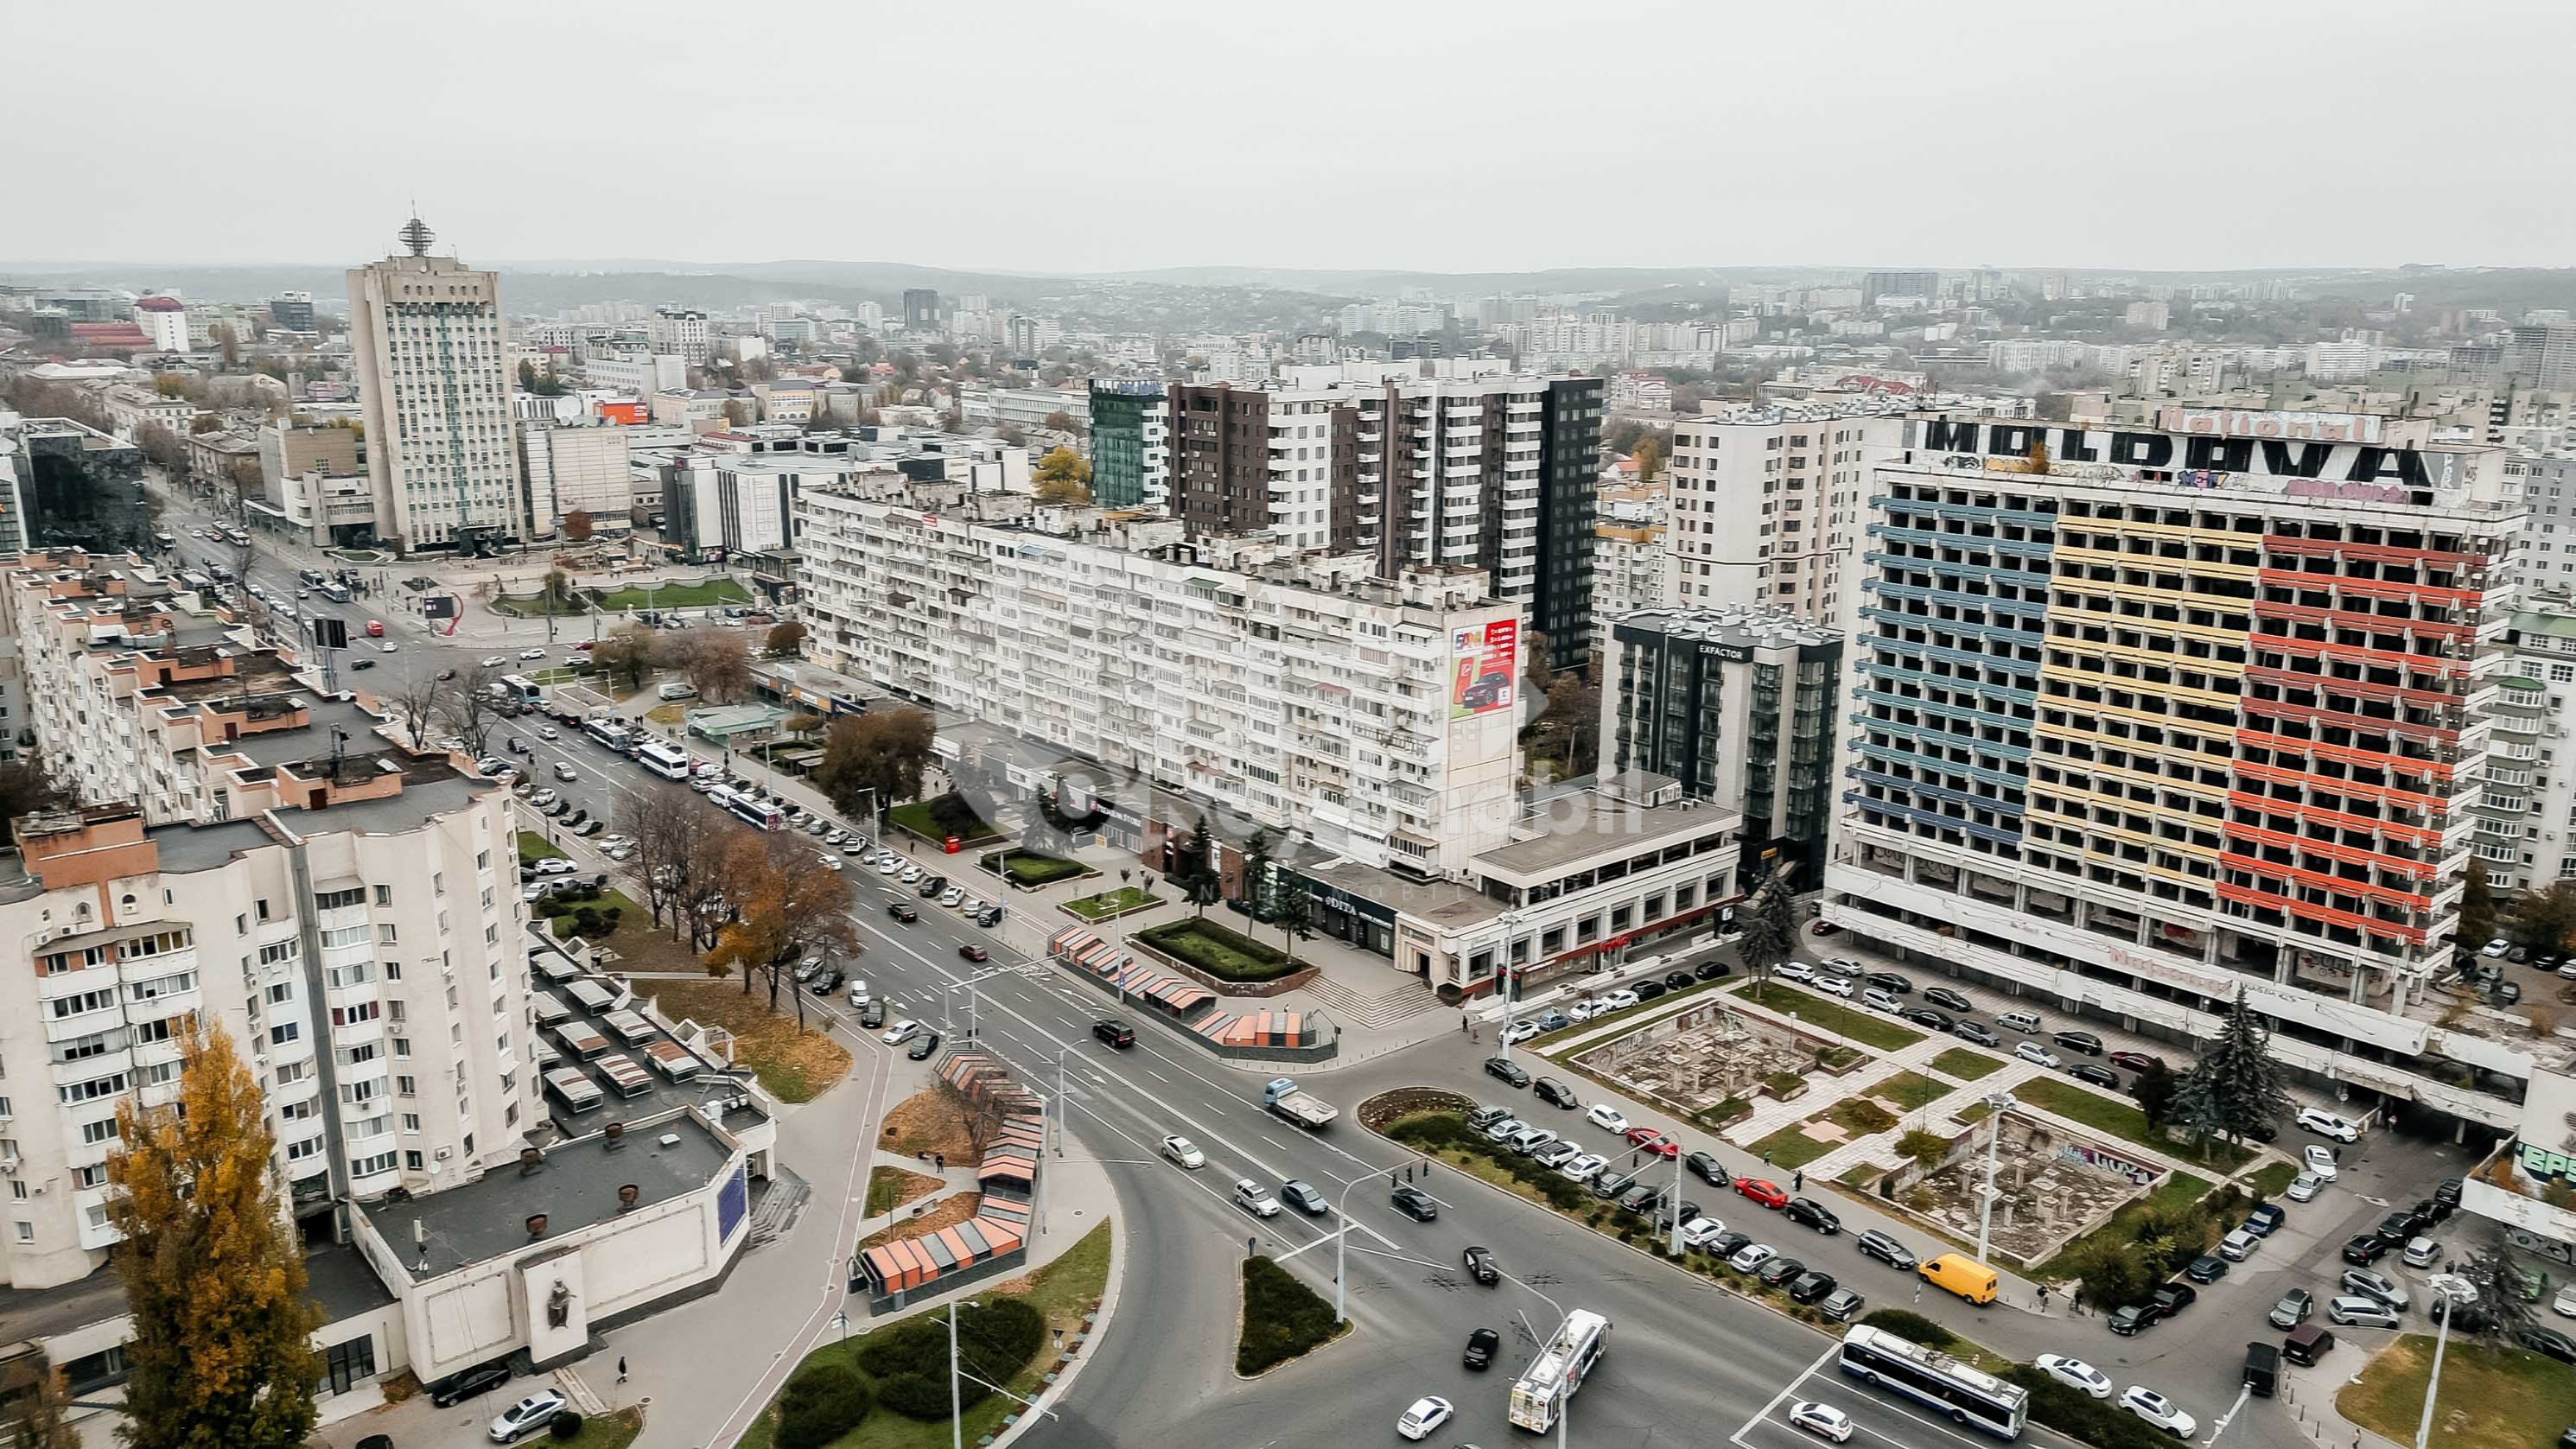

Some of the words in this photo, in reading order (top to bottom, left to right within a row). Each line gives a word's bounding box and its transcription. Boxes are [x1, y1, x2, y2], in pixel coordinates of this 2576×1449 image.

[1925, 420, 2434, 489] MOLDOVA
[1699, 645, 1743, 659] EXFACTOR
[1331, 897, 1358, 916] DITA
